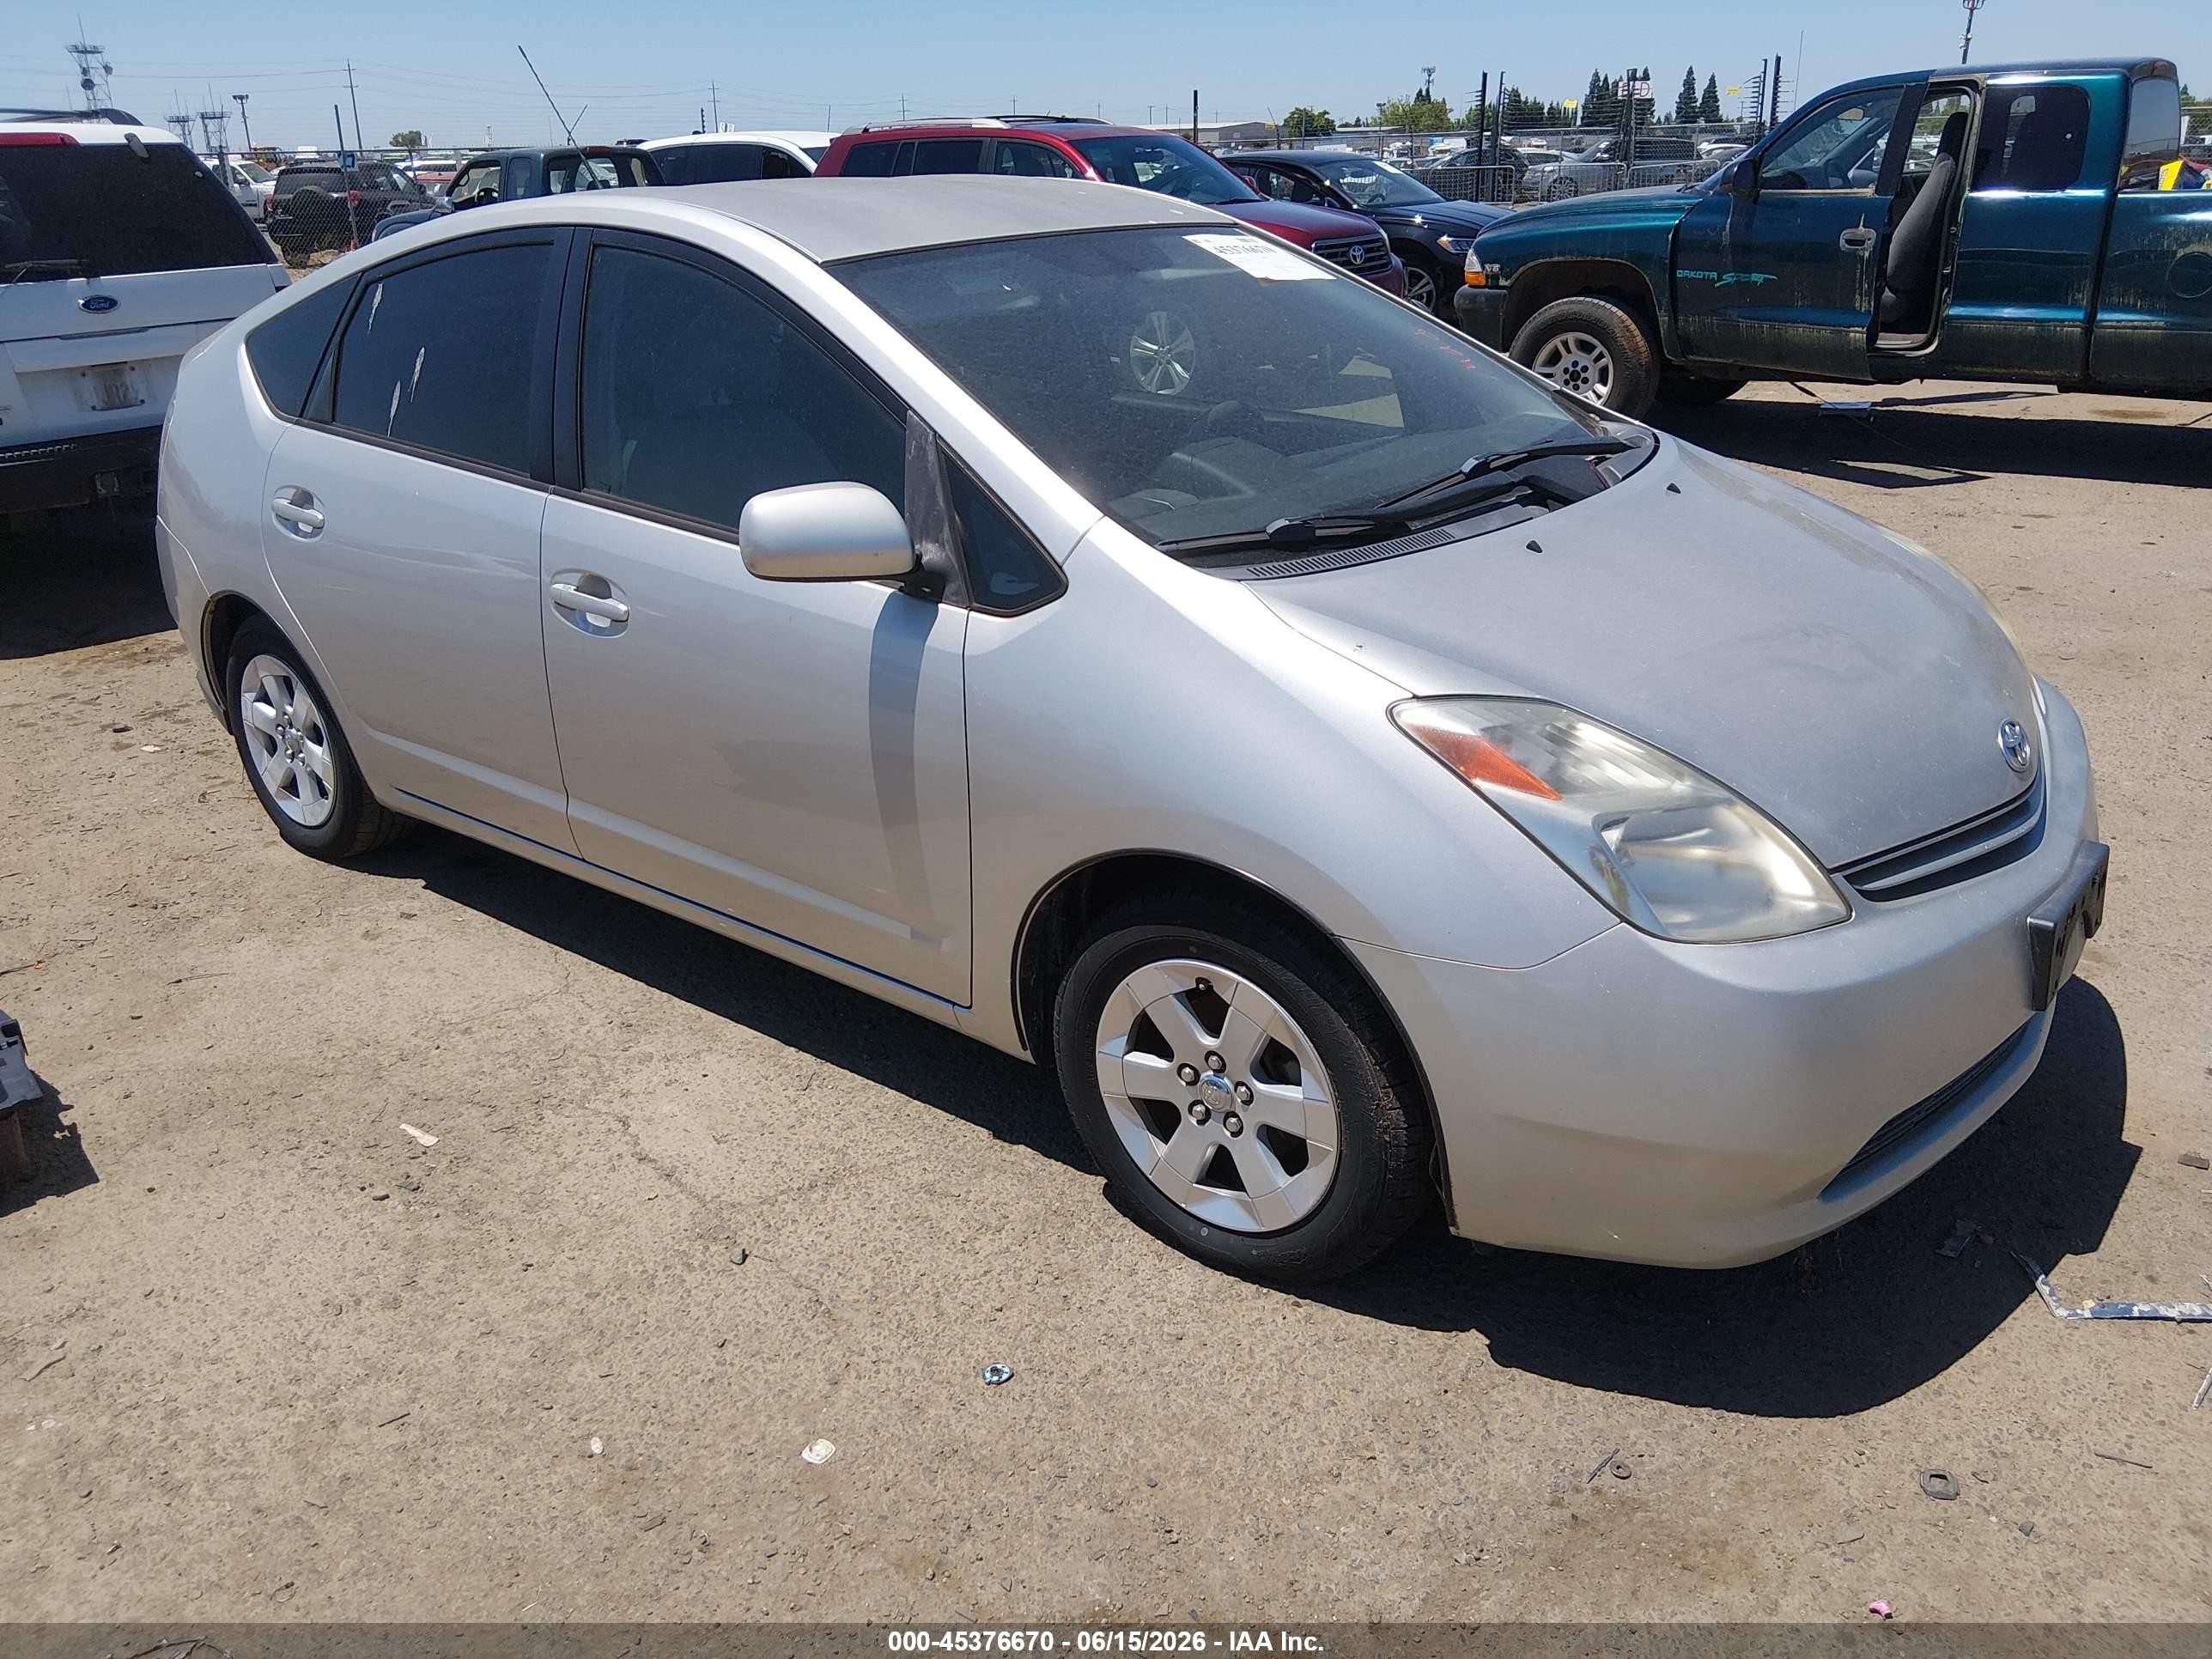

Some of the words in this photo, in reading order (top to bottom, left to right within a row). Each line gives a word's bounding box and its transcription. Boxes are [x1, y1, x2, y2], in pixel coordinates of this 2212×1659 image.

[1676, 270, 1717, 281] DAKOTA
[1715, 272, 1778, 288] SPORT
[89, 300, 111, 309] Ford
